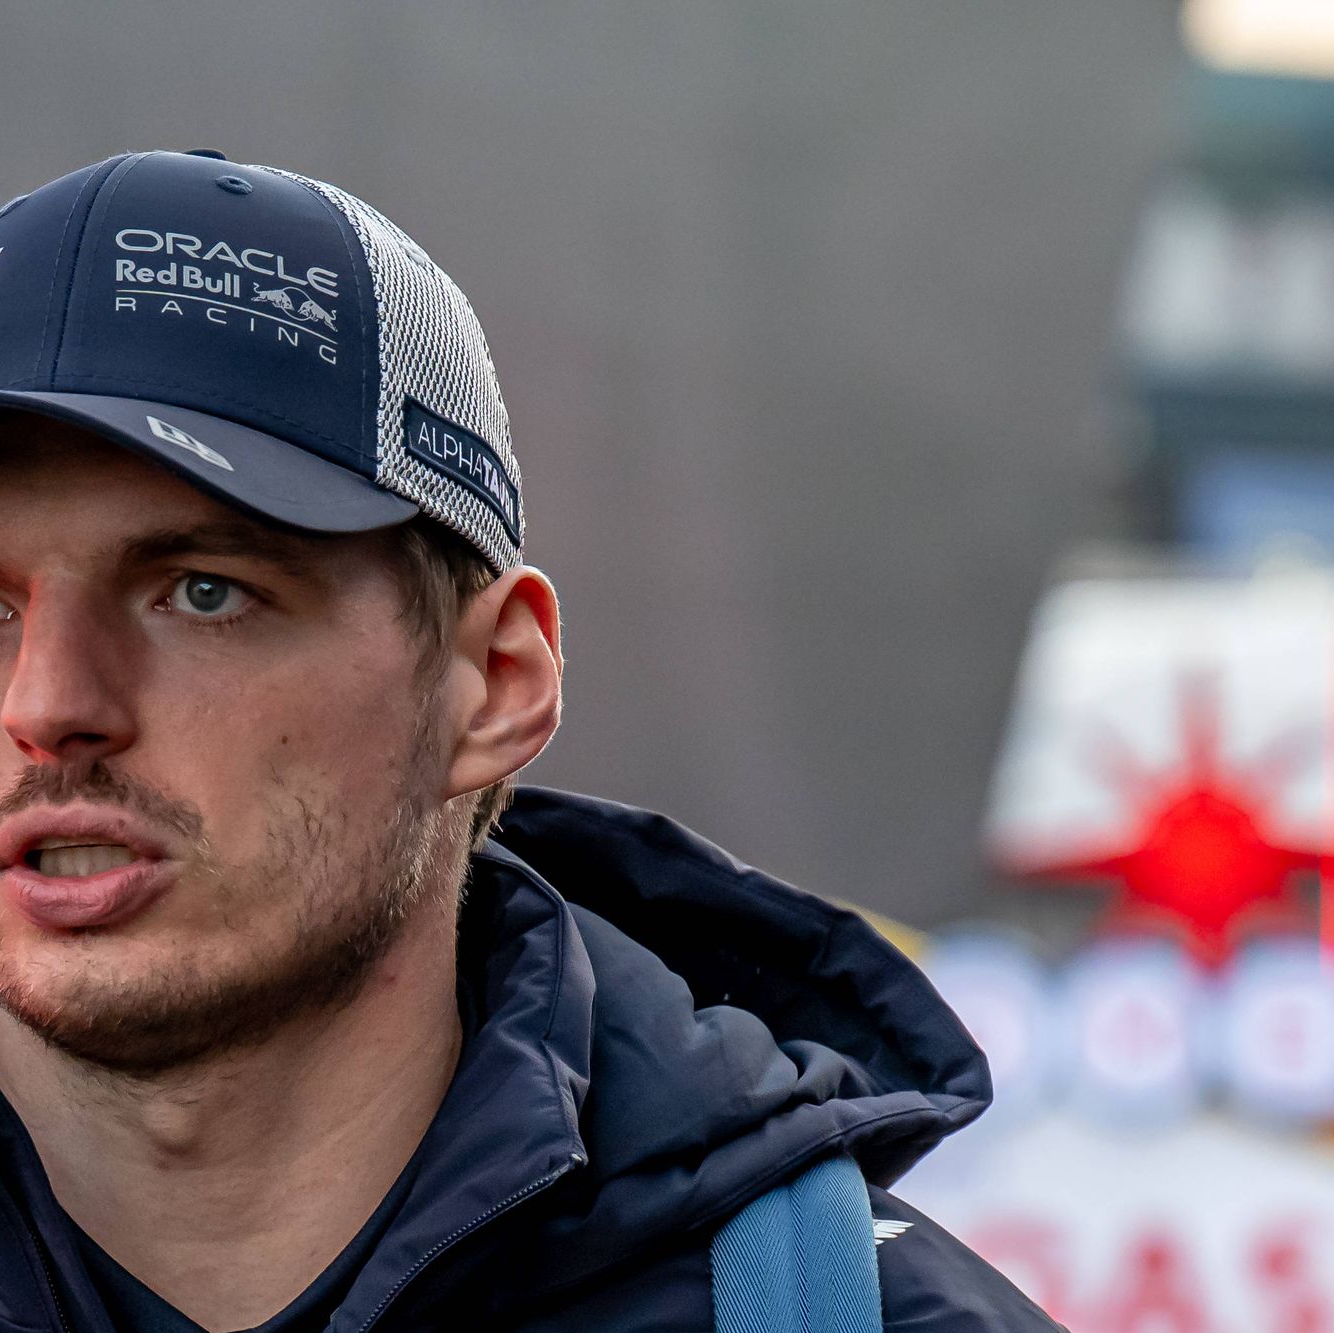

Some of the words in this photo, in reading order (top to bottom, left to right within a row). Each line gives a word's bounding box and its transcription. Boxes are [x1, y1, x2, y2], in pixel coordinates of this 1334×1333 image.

[115, 228, 339, 298] ORACLE
[115, 259, 177, 286] Red
[182, 264, 240, 299] Bull
[115, 296, 338, 365] RACING
